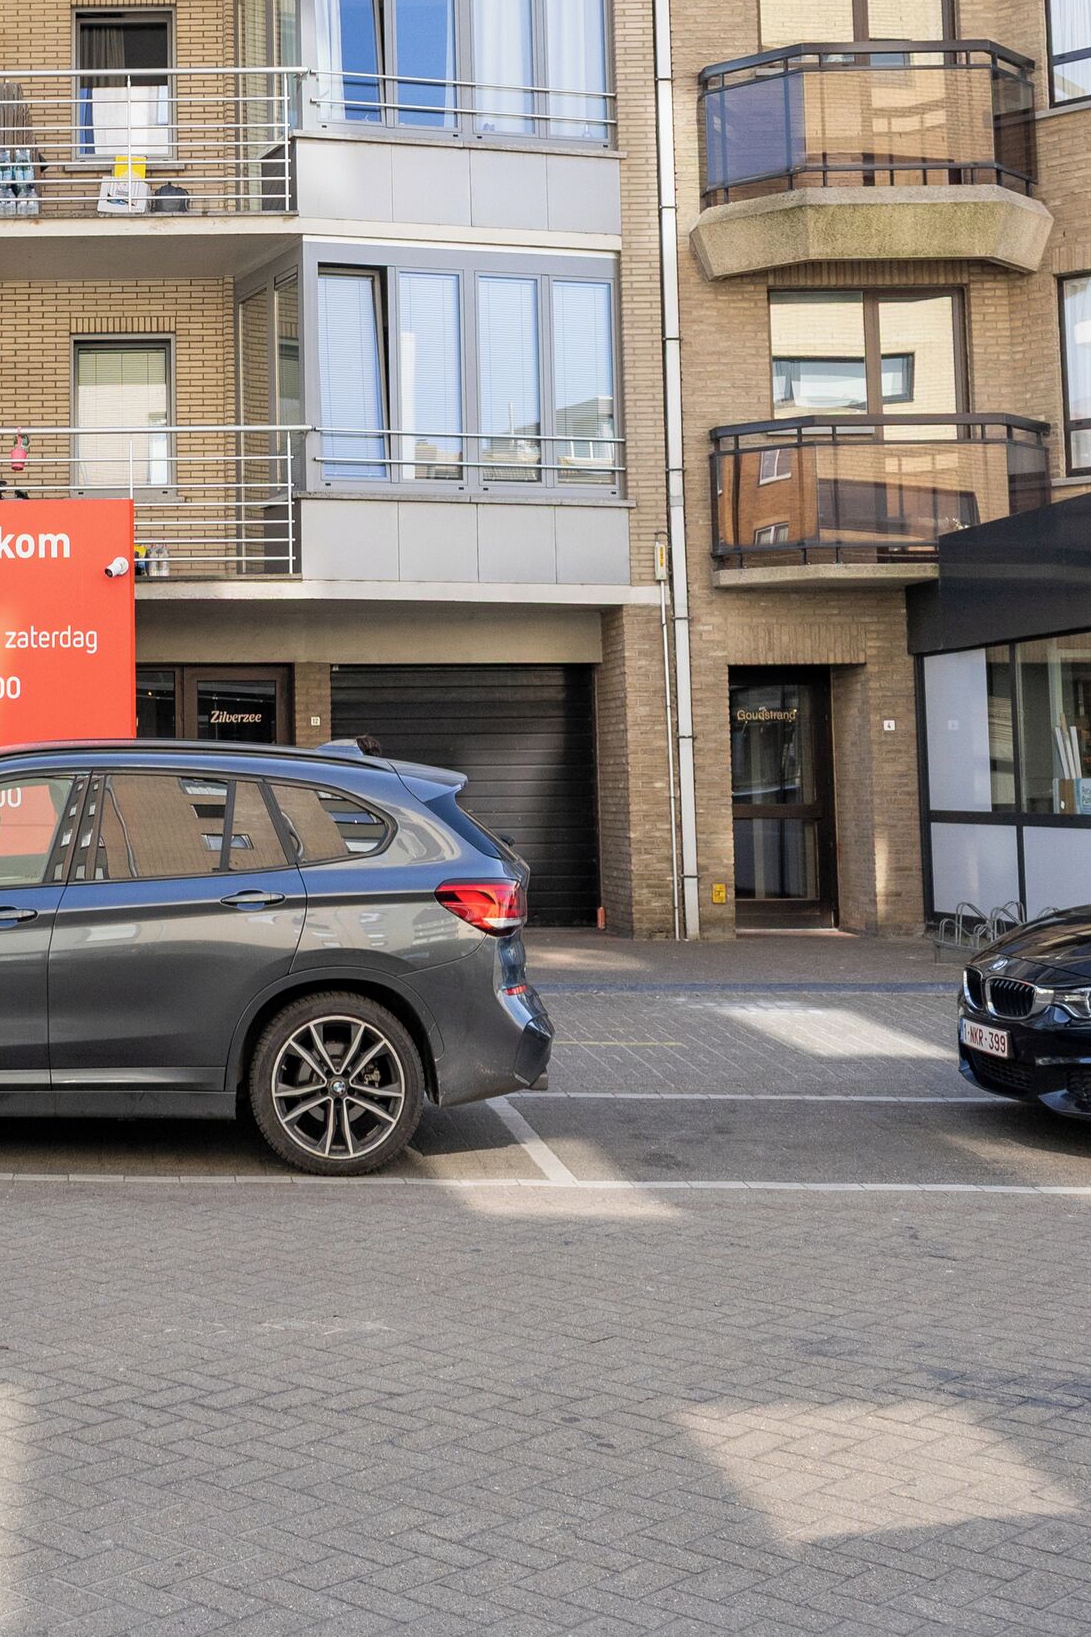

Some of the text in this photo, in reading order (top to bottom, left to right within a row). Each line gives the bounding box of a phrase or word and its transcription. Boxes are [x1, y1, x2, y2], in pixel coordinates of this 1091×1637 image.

[4, 625, 98, 654] zaterdag
[210, 710, 262, 723] Zilverzee
[736, 709, 797, 722] Goudstrand
